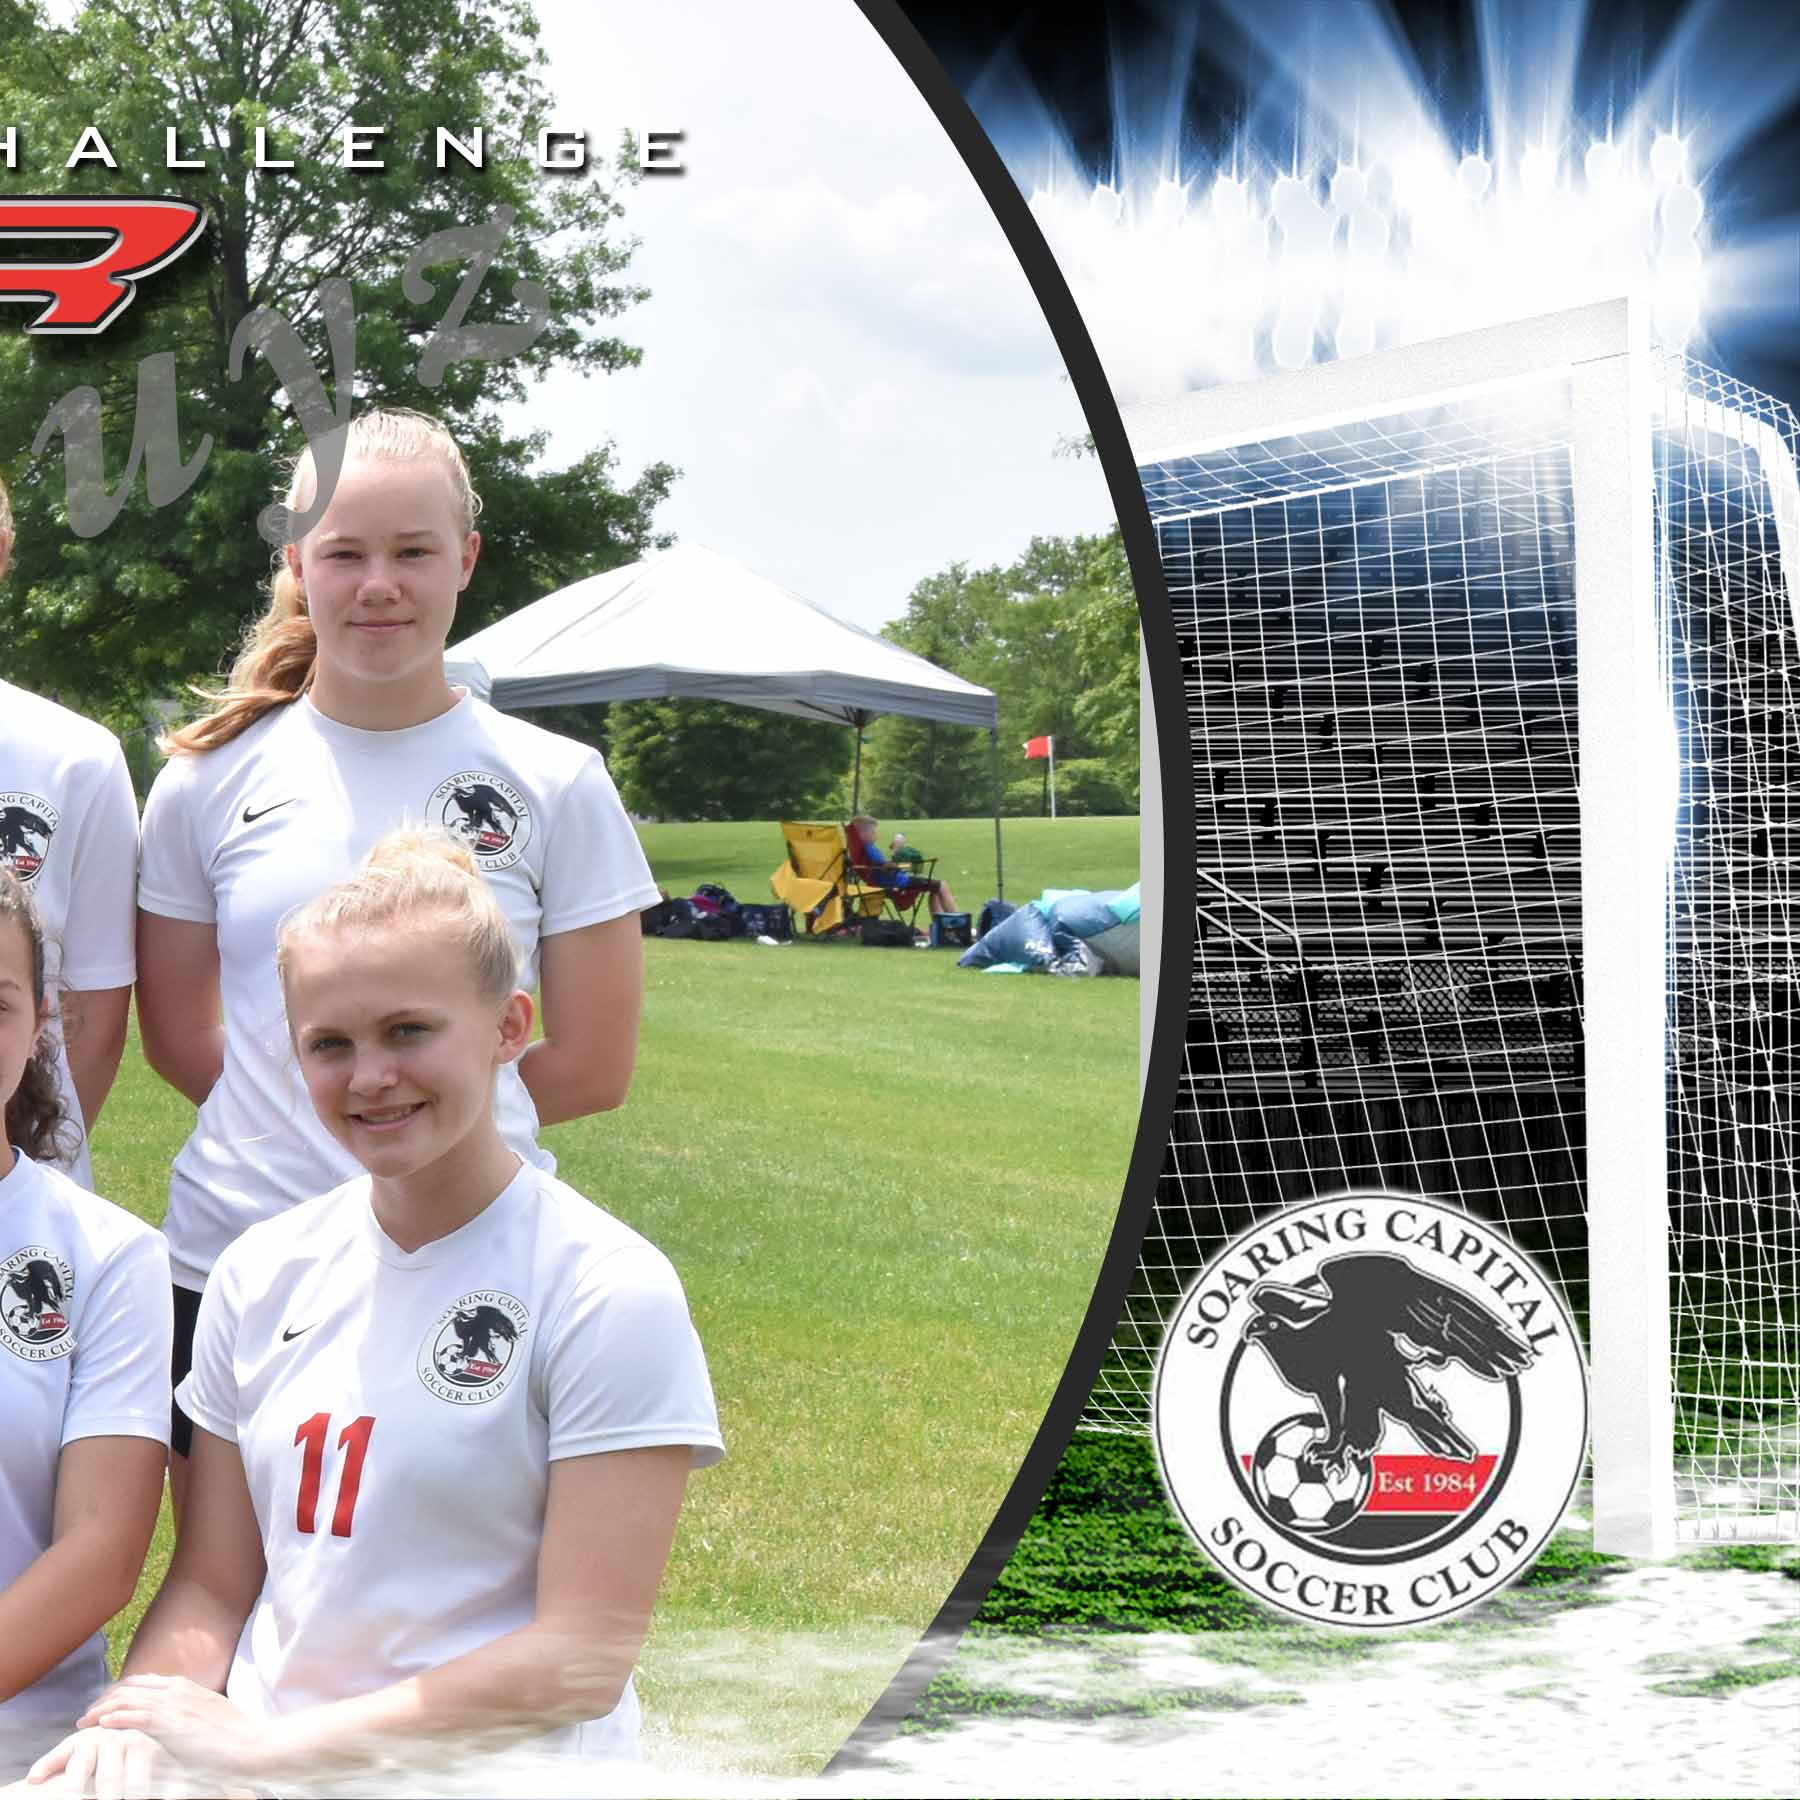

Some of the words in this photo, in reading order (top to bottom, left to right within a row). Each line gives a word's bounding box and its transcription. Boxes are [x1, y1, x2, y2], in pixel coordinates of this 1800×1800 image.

[19, 795, 58, 833] CAPITA
[435, 773, 486, 800] SOARING
[489, 777, 529, 818] CAPITAL
[485, 852, 518, 869] CLUB
[497, 1295, 529, 1335] CAPITAL
[49, 1337, 76, 1356] CLU
[422, 1366, 464, 1401] SOCCER
[293, 1412, 377, 1538] 11
